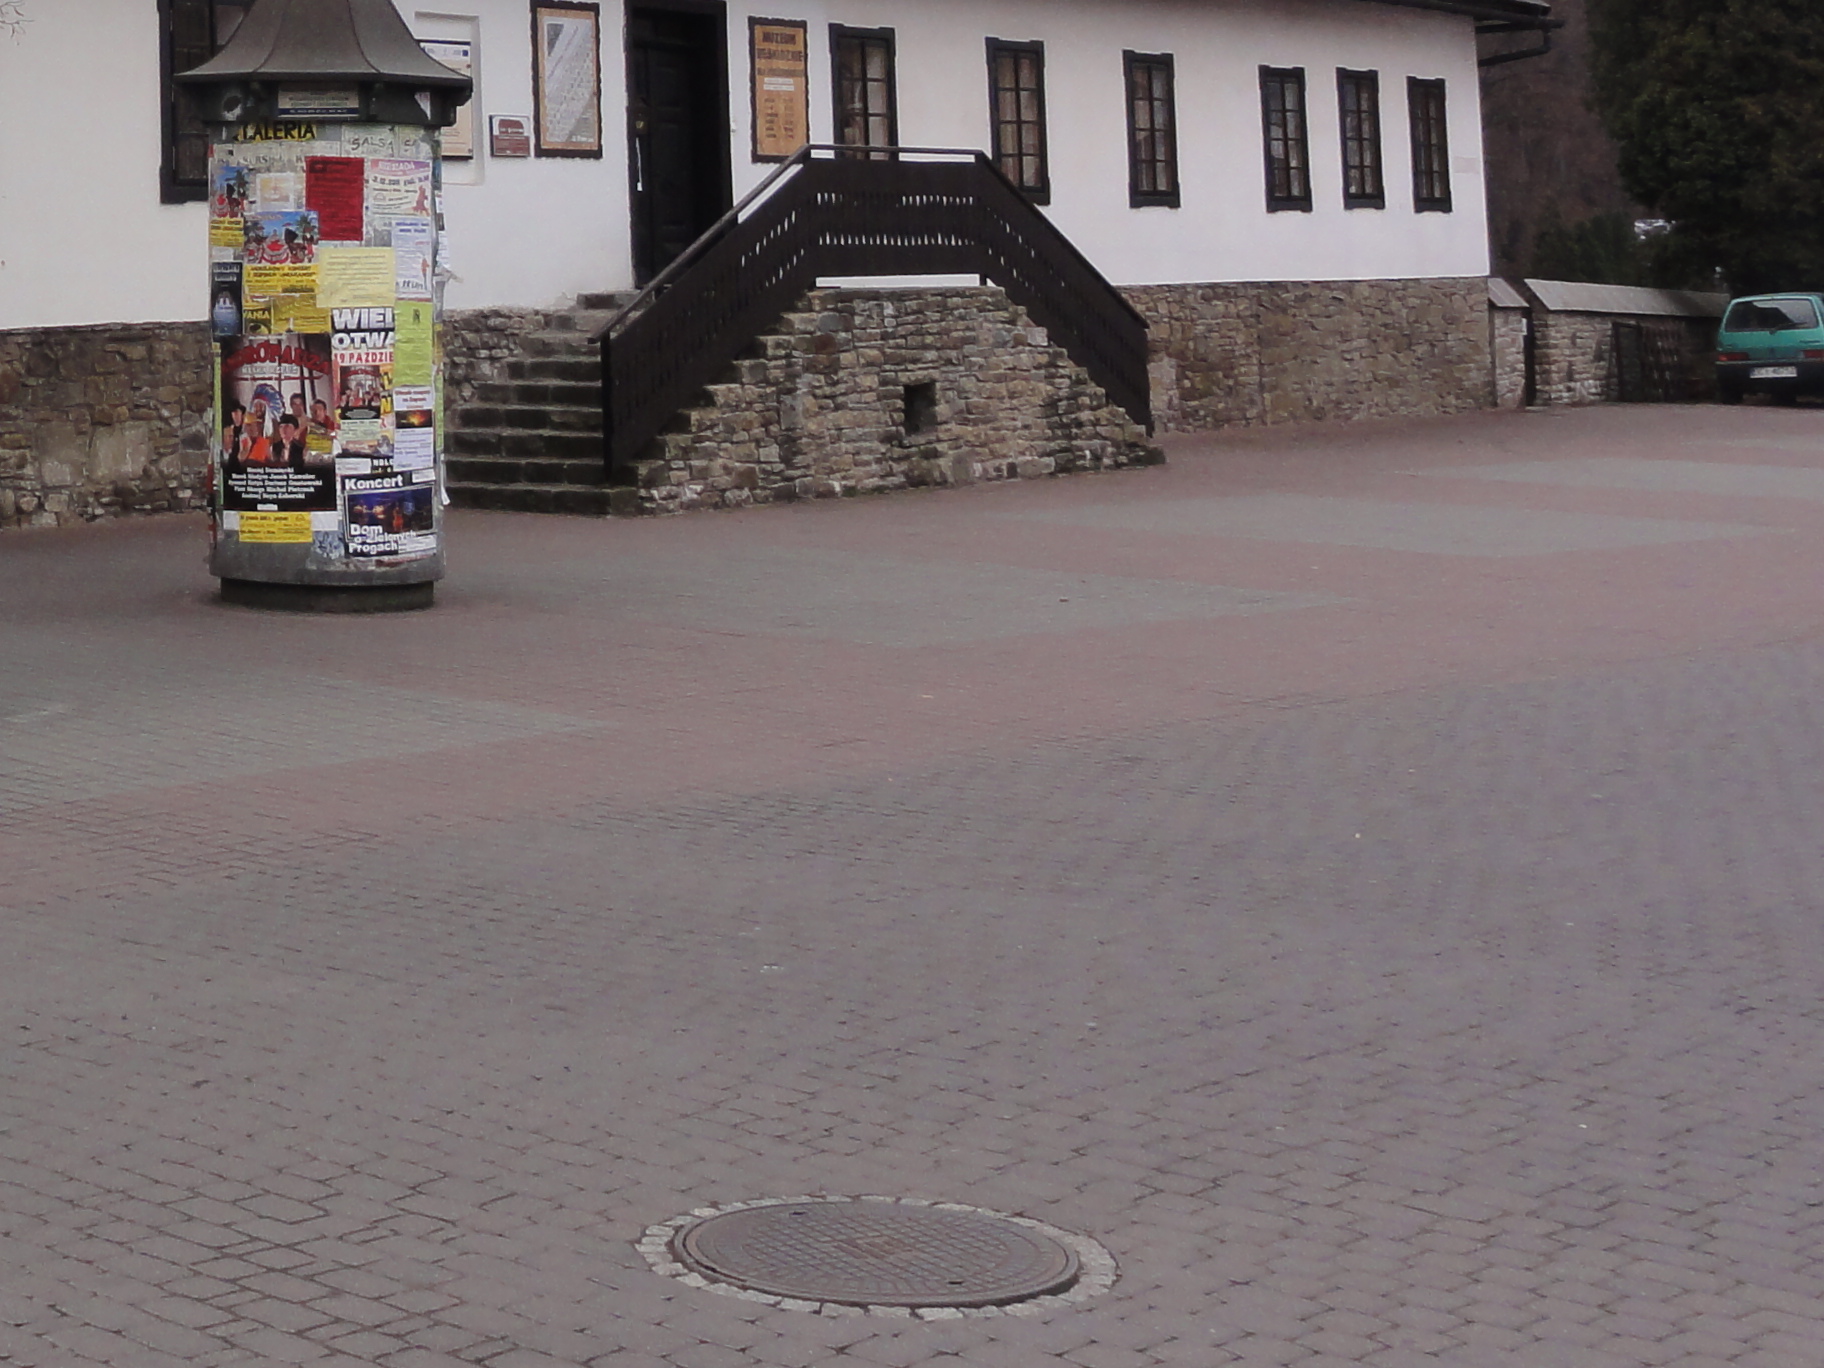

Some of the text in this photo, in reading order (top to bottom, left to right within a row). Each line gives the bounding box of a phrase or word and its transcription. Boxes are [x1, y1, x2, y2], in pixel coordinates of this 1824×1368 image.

[345, 474, 403, 490] Koncert
[350, 524, 383, 535] Dom
[348, 541, 398, 555] Progach
